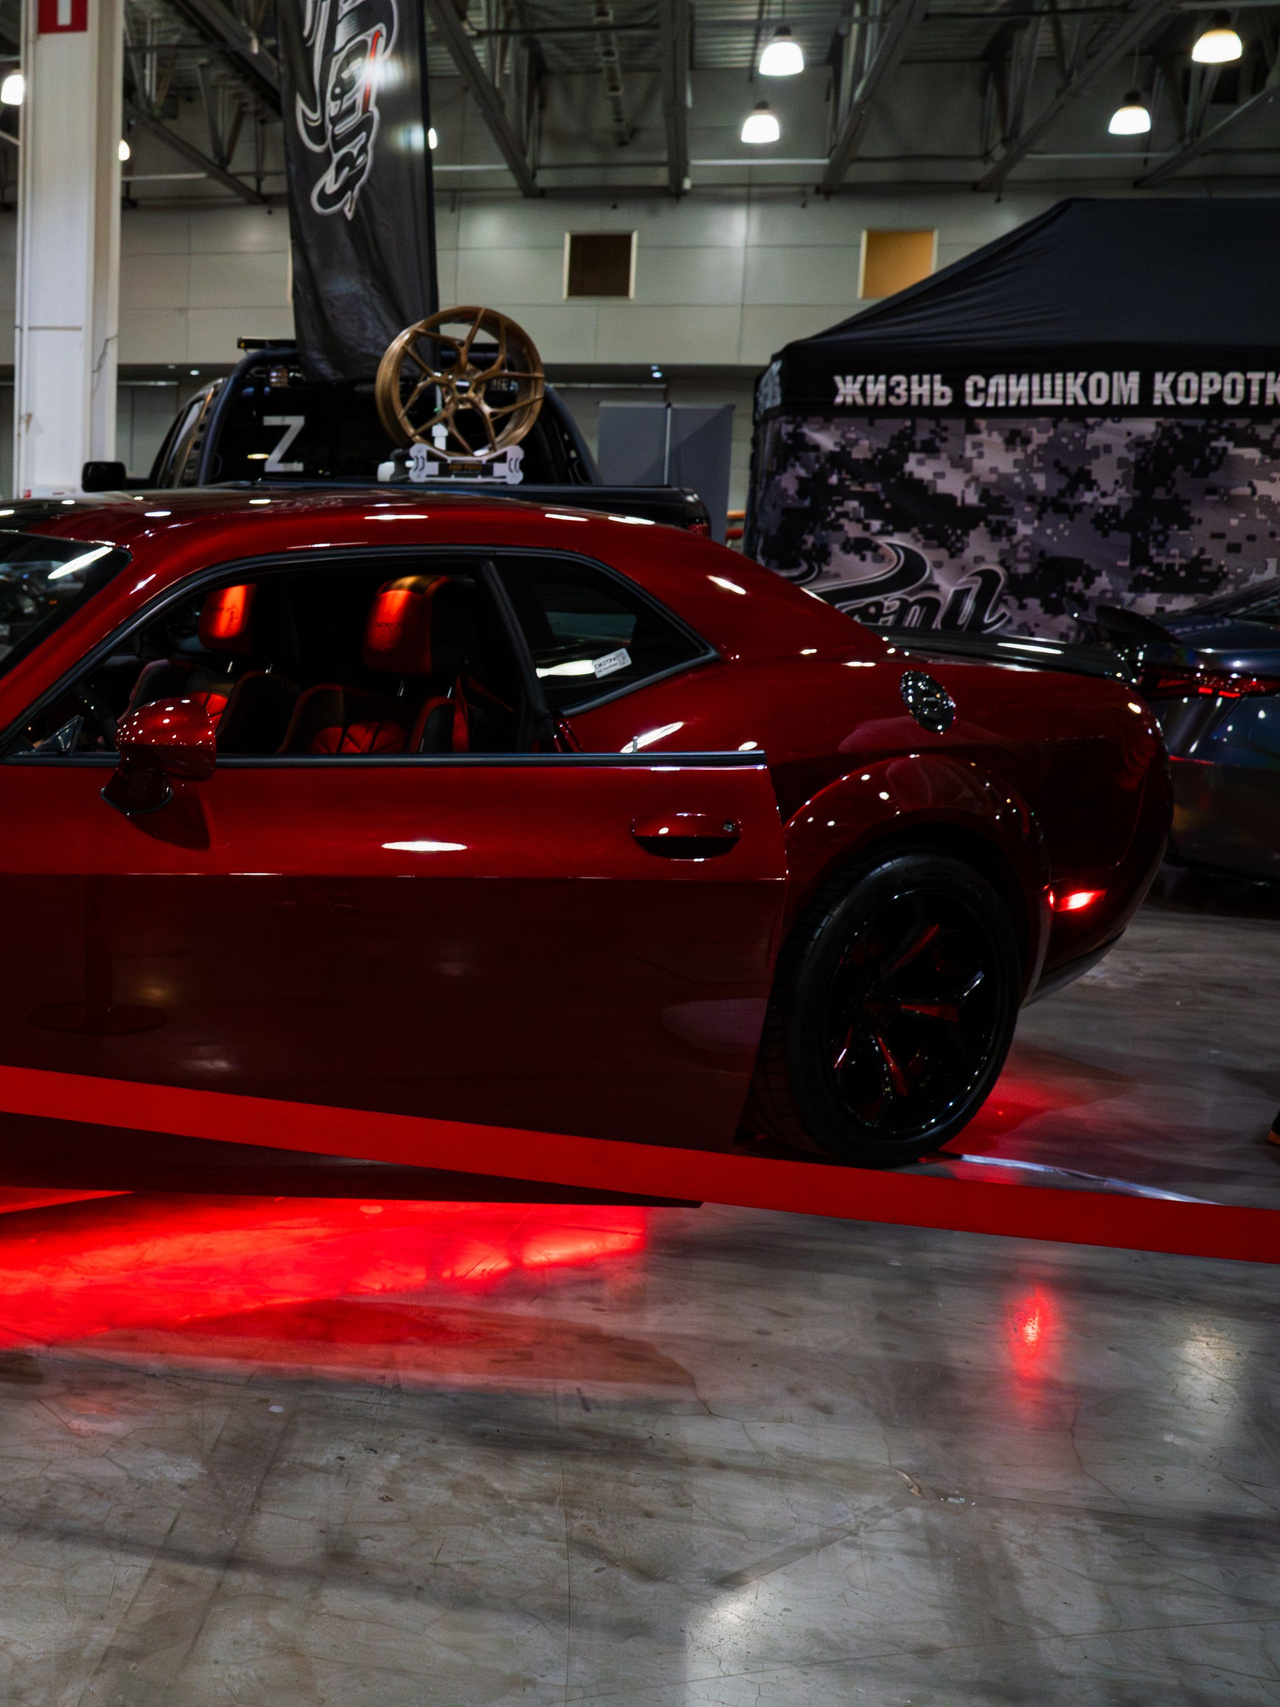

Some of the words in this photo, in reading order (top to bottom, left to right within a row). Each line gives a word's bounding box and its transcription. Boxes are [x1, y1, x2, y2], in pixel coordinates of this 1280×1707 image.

[832, 372, 954, 408] ЖИЗНЬ
[964, 369, 1141, 409] СЛИШКОМ
[261, 414, 306, 474] Z
